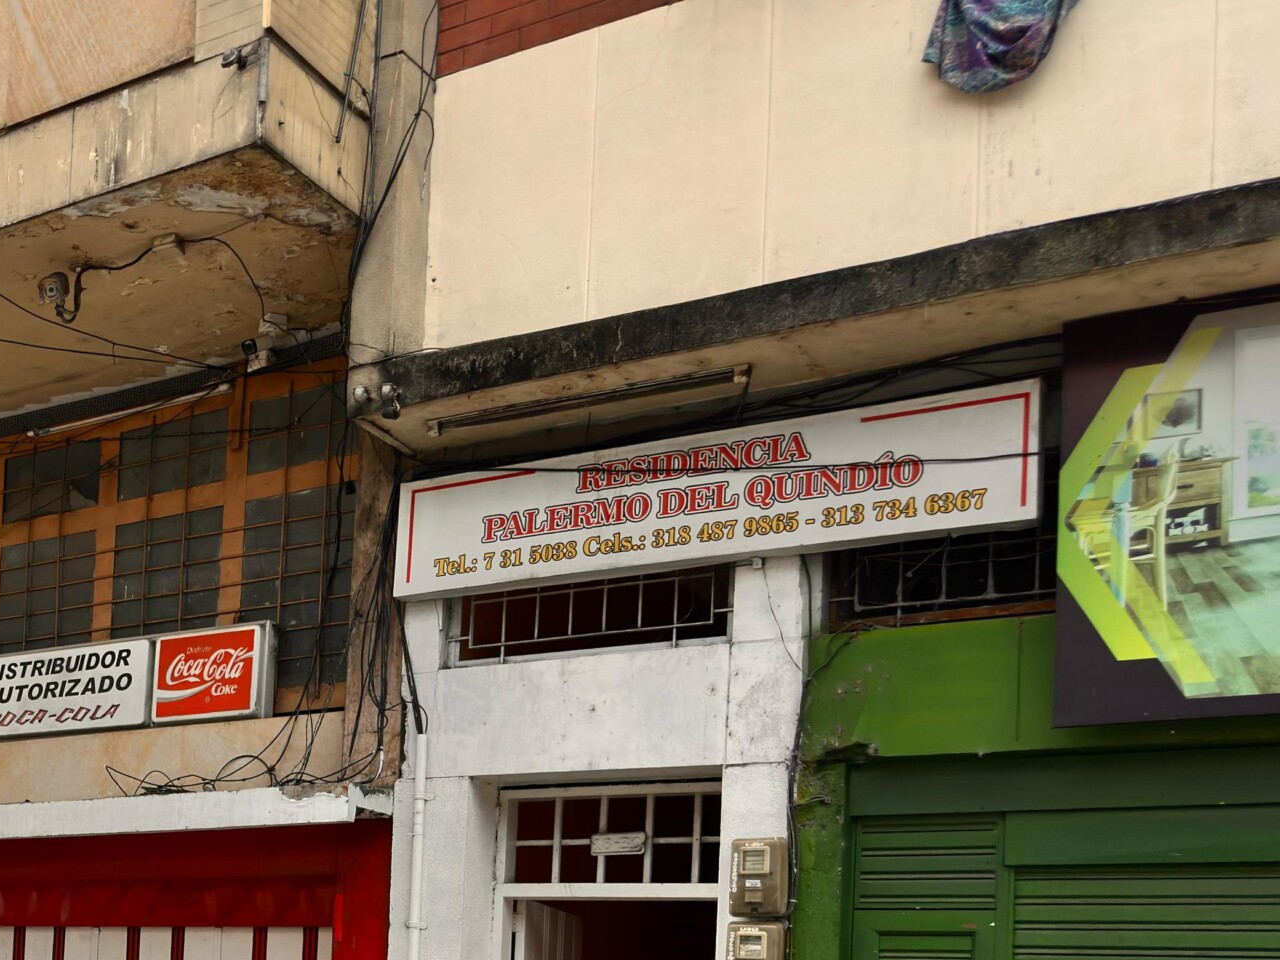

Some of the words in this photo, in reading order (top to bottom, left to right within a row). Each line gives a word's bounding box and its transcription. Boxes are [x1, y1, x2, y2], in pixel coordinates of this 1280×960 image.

[576, 432, 810, 493] RESIDENCIA
[481, 493, 652, 543] PALERMO
[657, 482, 739, 518] DEL
[744, 451, 924, 509] QUINDÍO
[434, 554, 478, 577] Tel.:
[499, 548, 523, 568] 31
[528, 541, 577, 564] 5038
[582, 533, 646, 557] Cels.:
[650, 525, 691, 549] 318
[697, 520, 738, 542] 487
[743, 511, 799, 537] 9865
[820, 504, 865, 528] 313
[873, 497, 917, 522] 734
[924, 488, 988, 515] 6367
[165, 647, 248, 686] Coca-Cola
[211, 682, 238, 696] Coke
